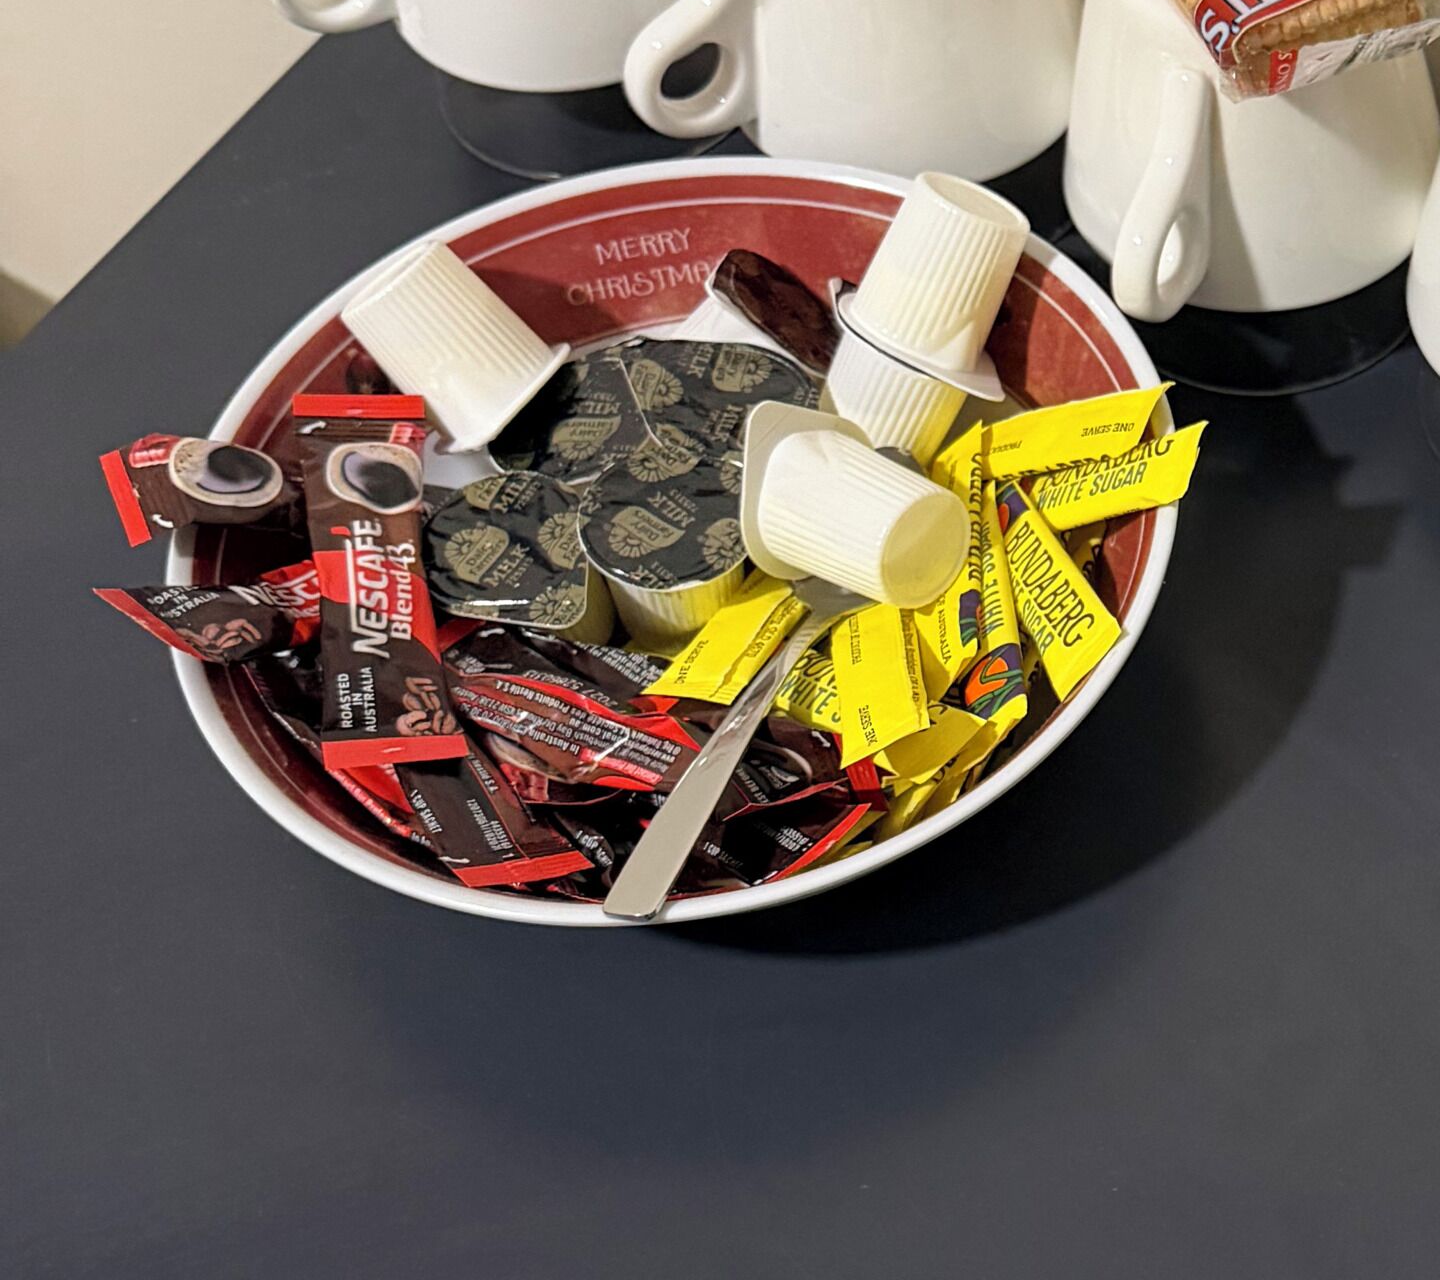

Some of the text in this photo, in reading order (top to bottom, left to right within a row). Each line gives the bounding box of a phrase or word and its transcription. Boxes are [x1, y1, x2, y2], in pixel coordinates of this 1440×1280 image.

[595, 227, 691, 265] MERRY
[567, 261, 714, 305] CHRISTMA
[1037, 477, 1088, 511] WHITE
[1089, 461, 1148, 498] SUGAR
[645, 491, 696, 530] MILK
[482, 542, 530, 588] MILK
[1005, 520, 1095, 647] BUNDABERG
[390, 574, 413, 641] Blend
[339, 673, 353, 728] ROASTED
[353, 692, 363, 707] IN
[363, 666, 378, 733] AUSTRALIA
[412, 794, 428, 811] CUP
[420, 807, 443, 834] SACHET
